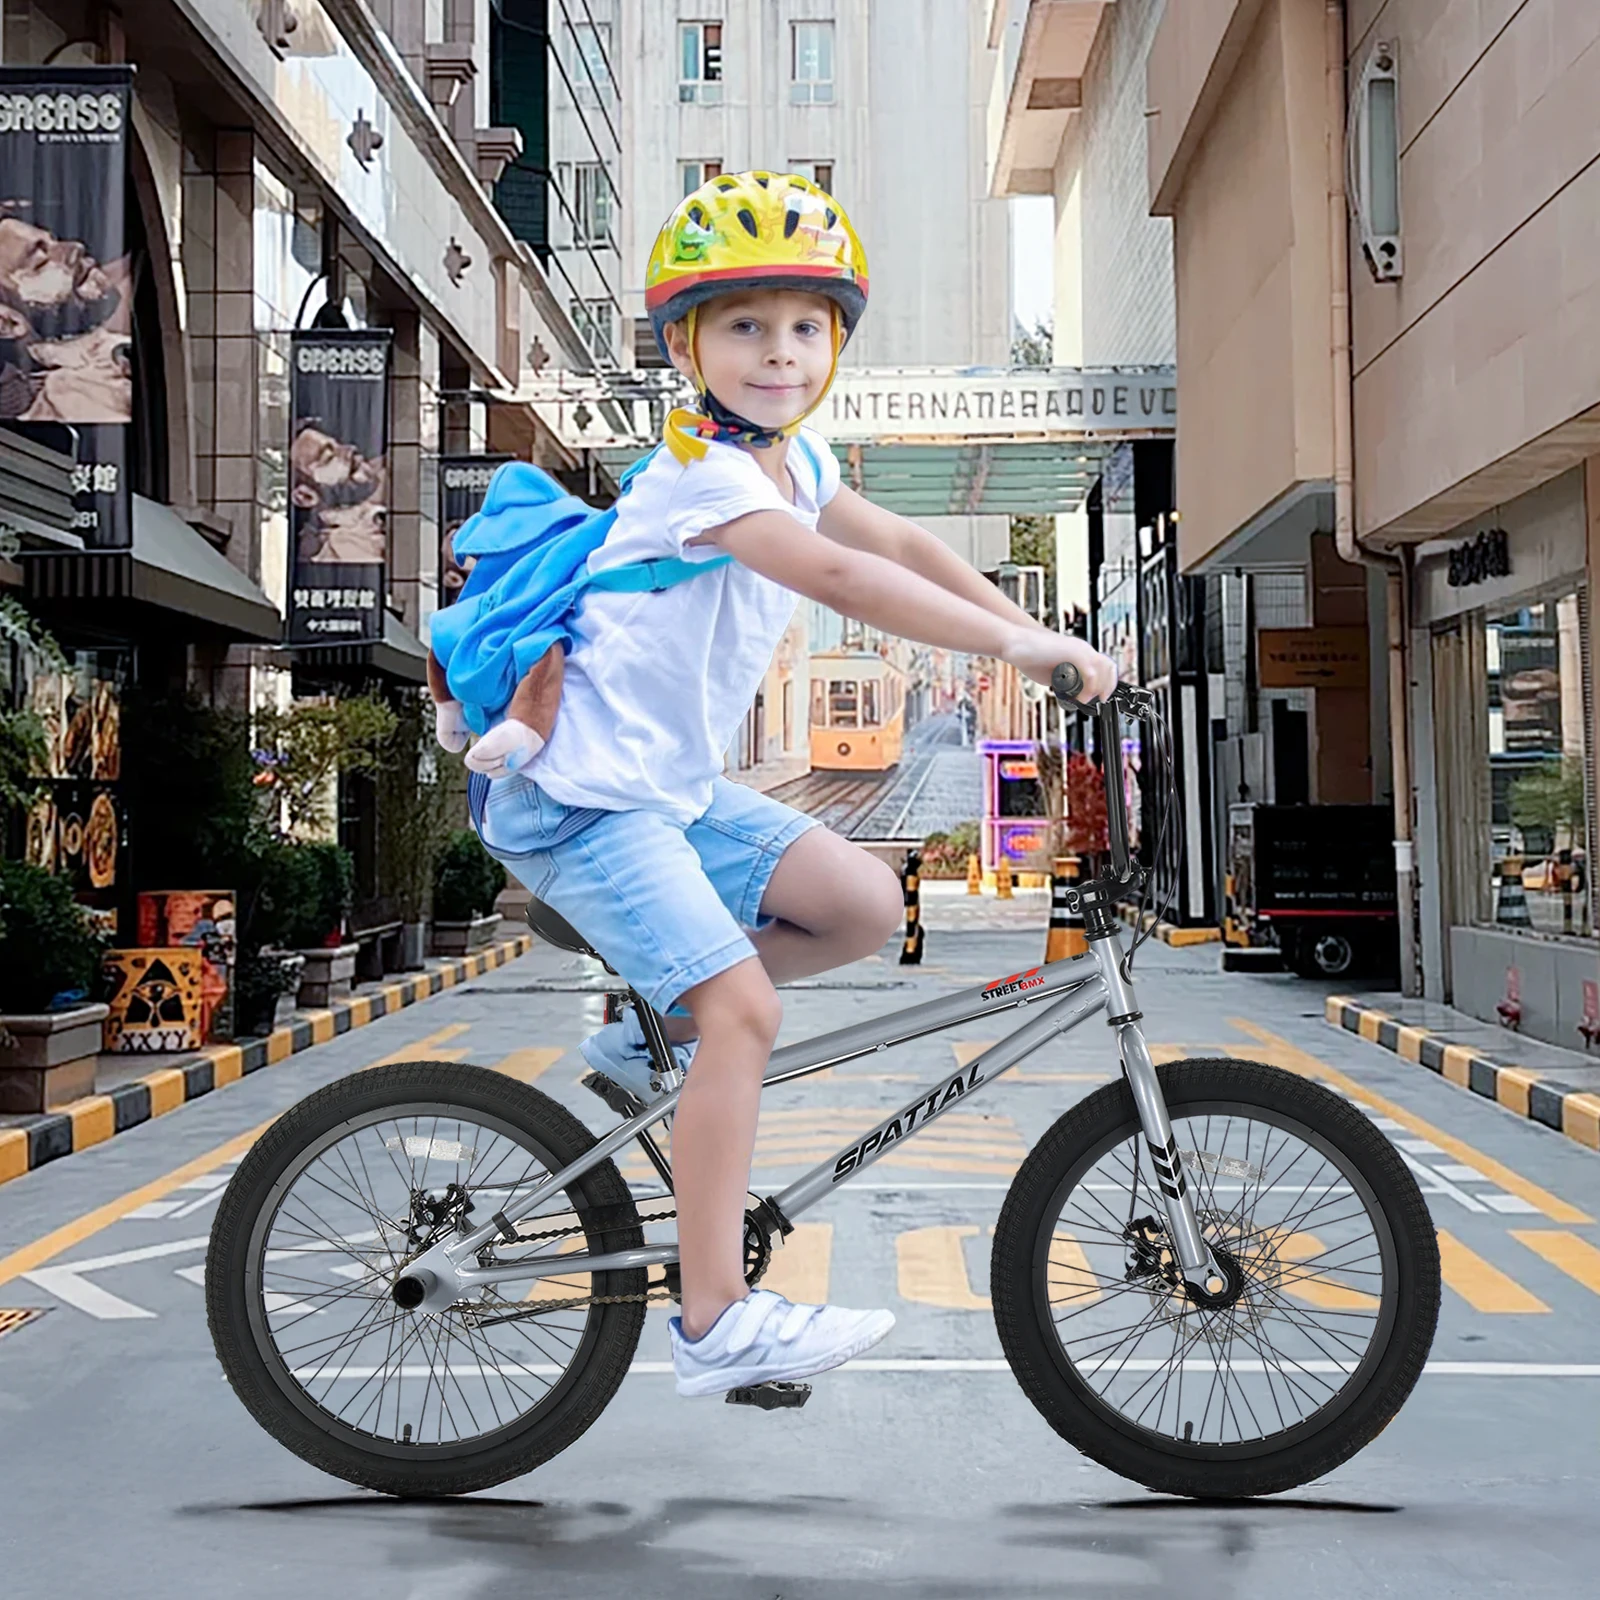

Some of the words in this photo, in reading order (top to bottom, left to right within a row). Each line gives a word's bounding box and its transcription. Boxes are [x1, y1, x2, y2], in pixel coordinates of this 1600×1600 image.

[981, 979, 1023, 1001] STREET
[1019, 976, 1045, 990] BMX
[832, 1063, 985, 1183] SPATIAL
